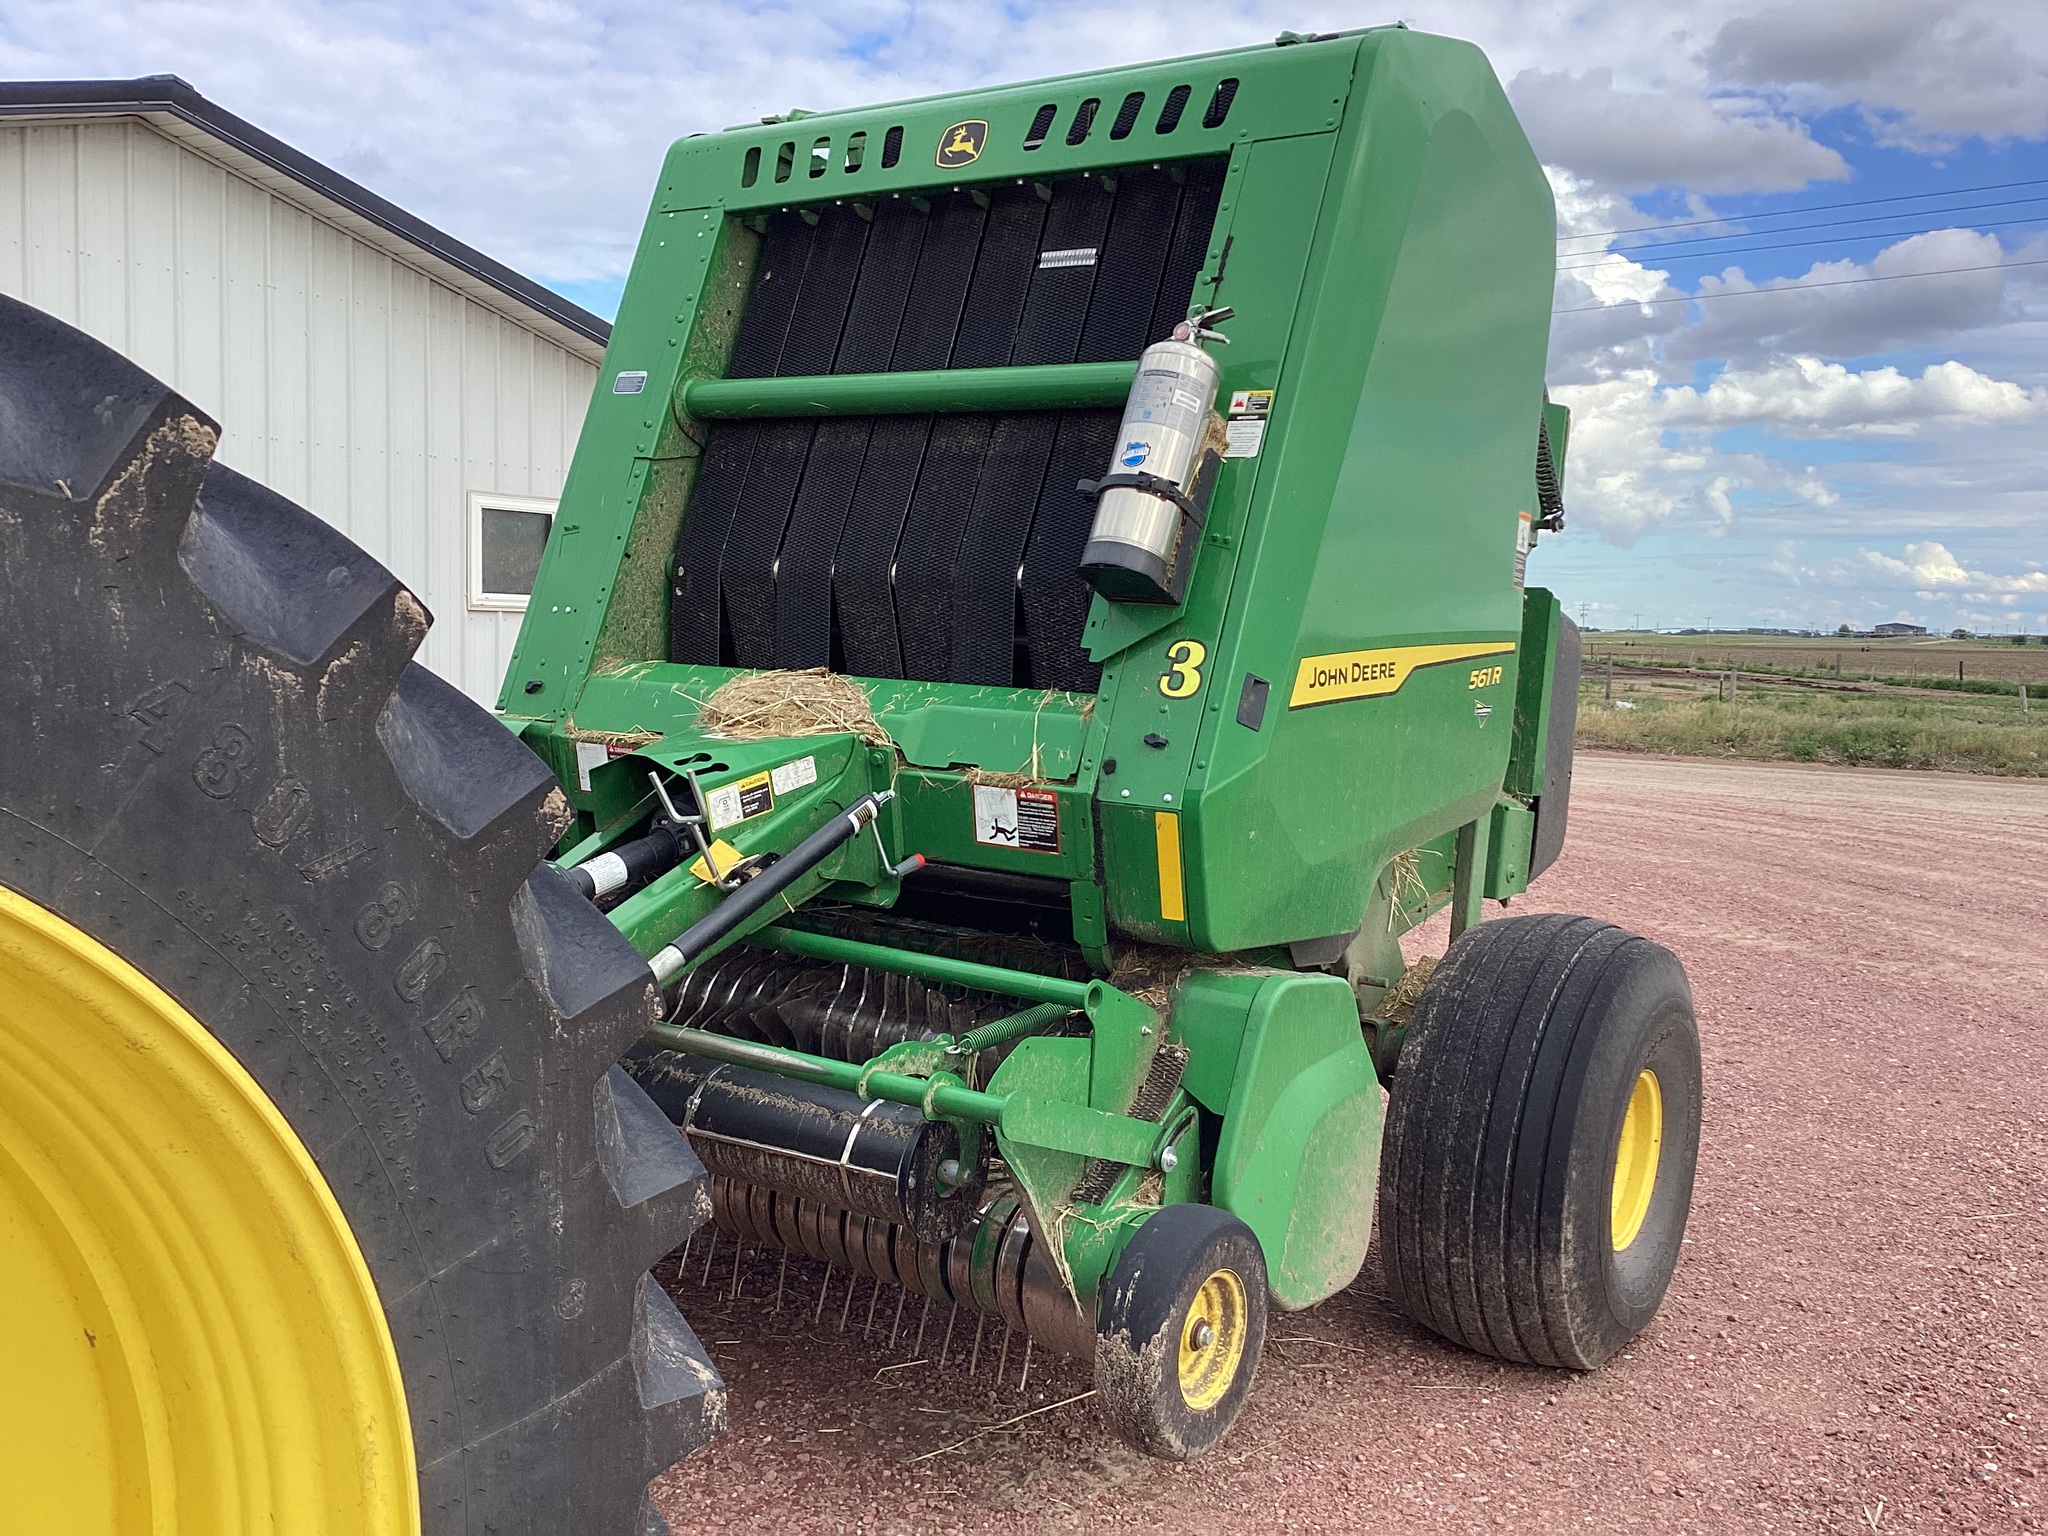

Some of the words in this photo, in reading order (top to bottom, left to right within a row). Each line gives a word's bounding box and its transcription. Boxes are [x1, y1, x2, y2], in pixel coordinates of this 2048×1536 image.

[1157, 637, 1208, 700] 3
[1309, 666, 1348, 689] JOHN
[1352, 661, 1396, 683] DEERE
[745, 776, 766, 787] CAUTION
[1026, 791, 1053, 802] DANGER
